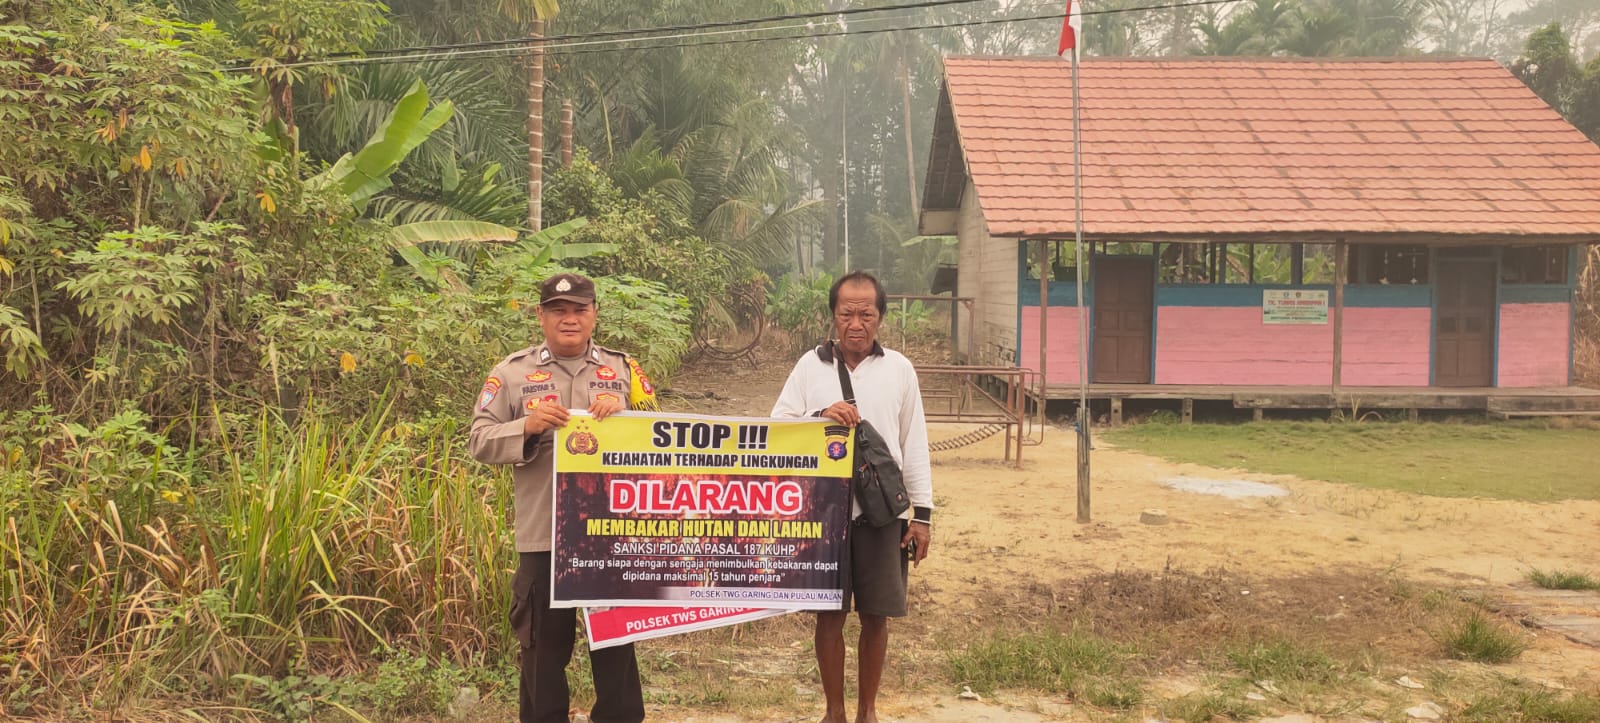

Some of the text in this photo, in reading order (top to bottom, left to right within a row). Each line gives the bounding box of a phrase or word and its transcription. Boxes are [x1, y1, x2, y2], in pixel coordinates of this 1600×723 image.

[589, 381, 622, 391] POLRI
[652, 421, 769, 449] STOP !!!
[602, 452, 819, 469] KEJAHATAN TERHADAP LINGKUNGAN
[611, 481, 801, 514] DILARANG
[586, 519, 822, 539] MEMBAKAR HUTAN DAN LAHAN
[613, 542, 796, 556] SANKSI PIDANA PASAL 187 KUHP
[607, 558, 631, 570] siapa
[633, 558, 667, 570] dengan
[669, 559, 704, 570] sengaja
[706, 559, 766, 569] menimbulkan
[767, 560, 813, 570] kebakaran
[814, 560, 839, 573] dapat
[622, 571, 661, 582] dipidana
[663, 571, 706, 581] maksimal
[708, 572, 719, 581] 15
[720, 572, 746, 581] tahun
[690, 590, 721, 598] POLSEK
[742, 591, 772, 599] GARING
[773, 592, 789, 600] DAN
[791, 592, 816, 600] PULAU
[625, 615, 670, 633] POLSEK
[671, 611, 697, 624] TWS
